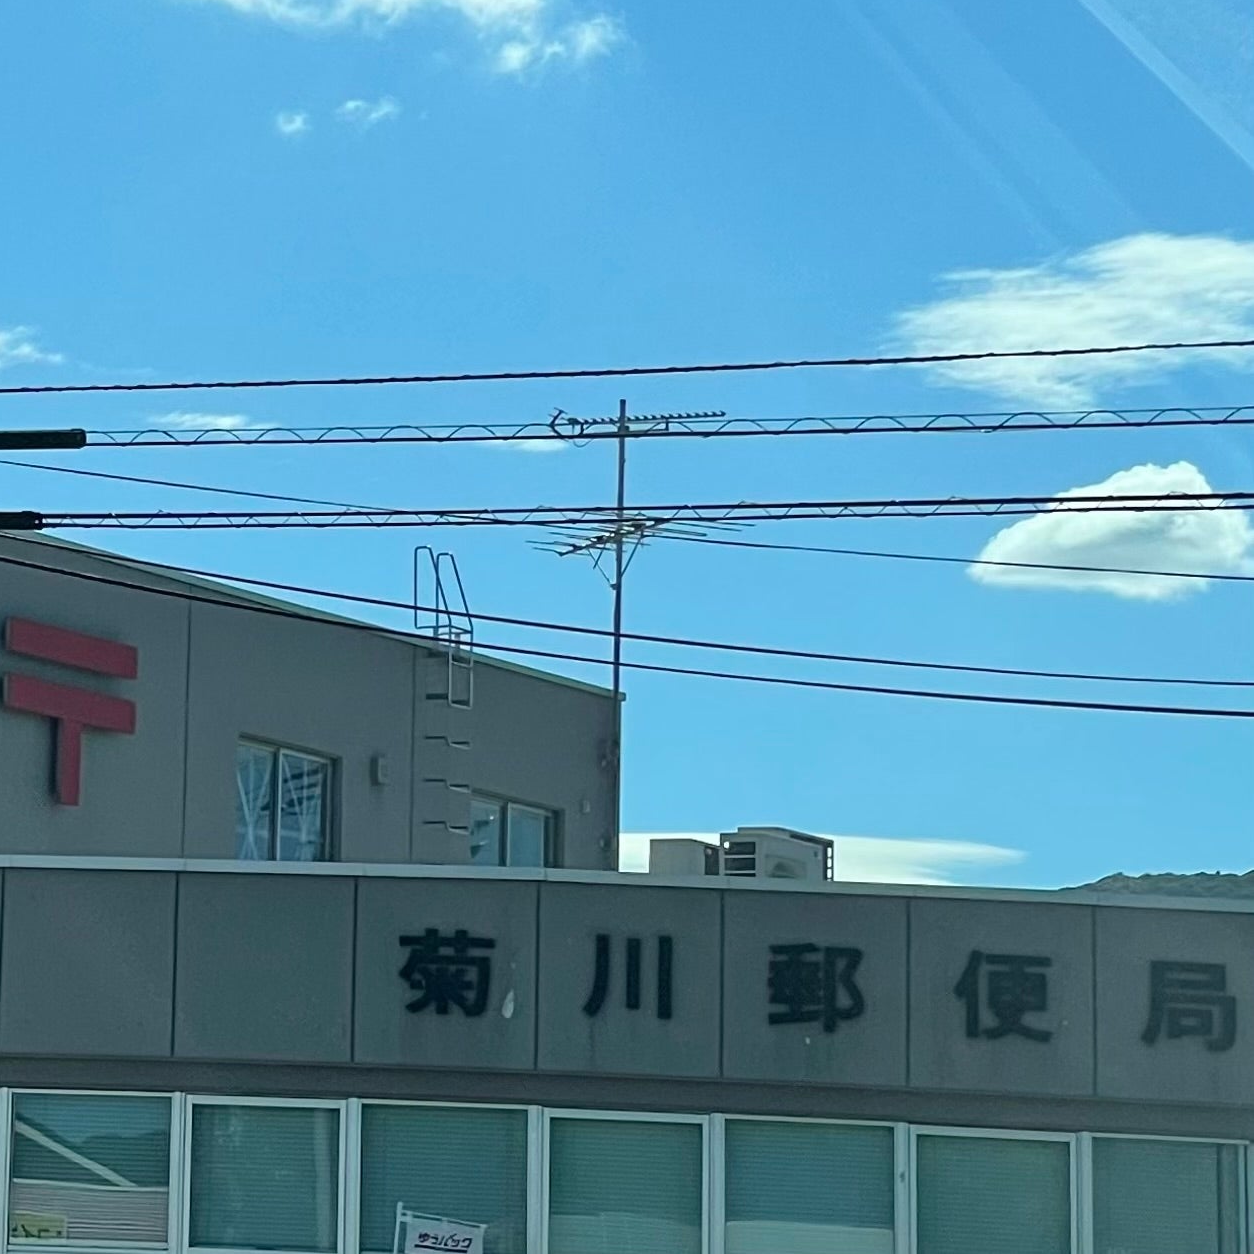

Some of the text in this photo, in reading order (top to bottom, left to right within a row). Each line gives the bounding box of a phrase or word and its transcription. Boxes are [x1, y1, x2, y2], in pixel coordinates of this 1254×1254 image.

[398, 927, 1237, 1052] 菊川郵便局
[418, 1232, 473, 1249] ゆうパック
